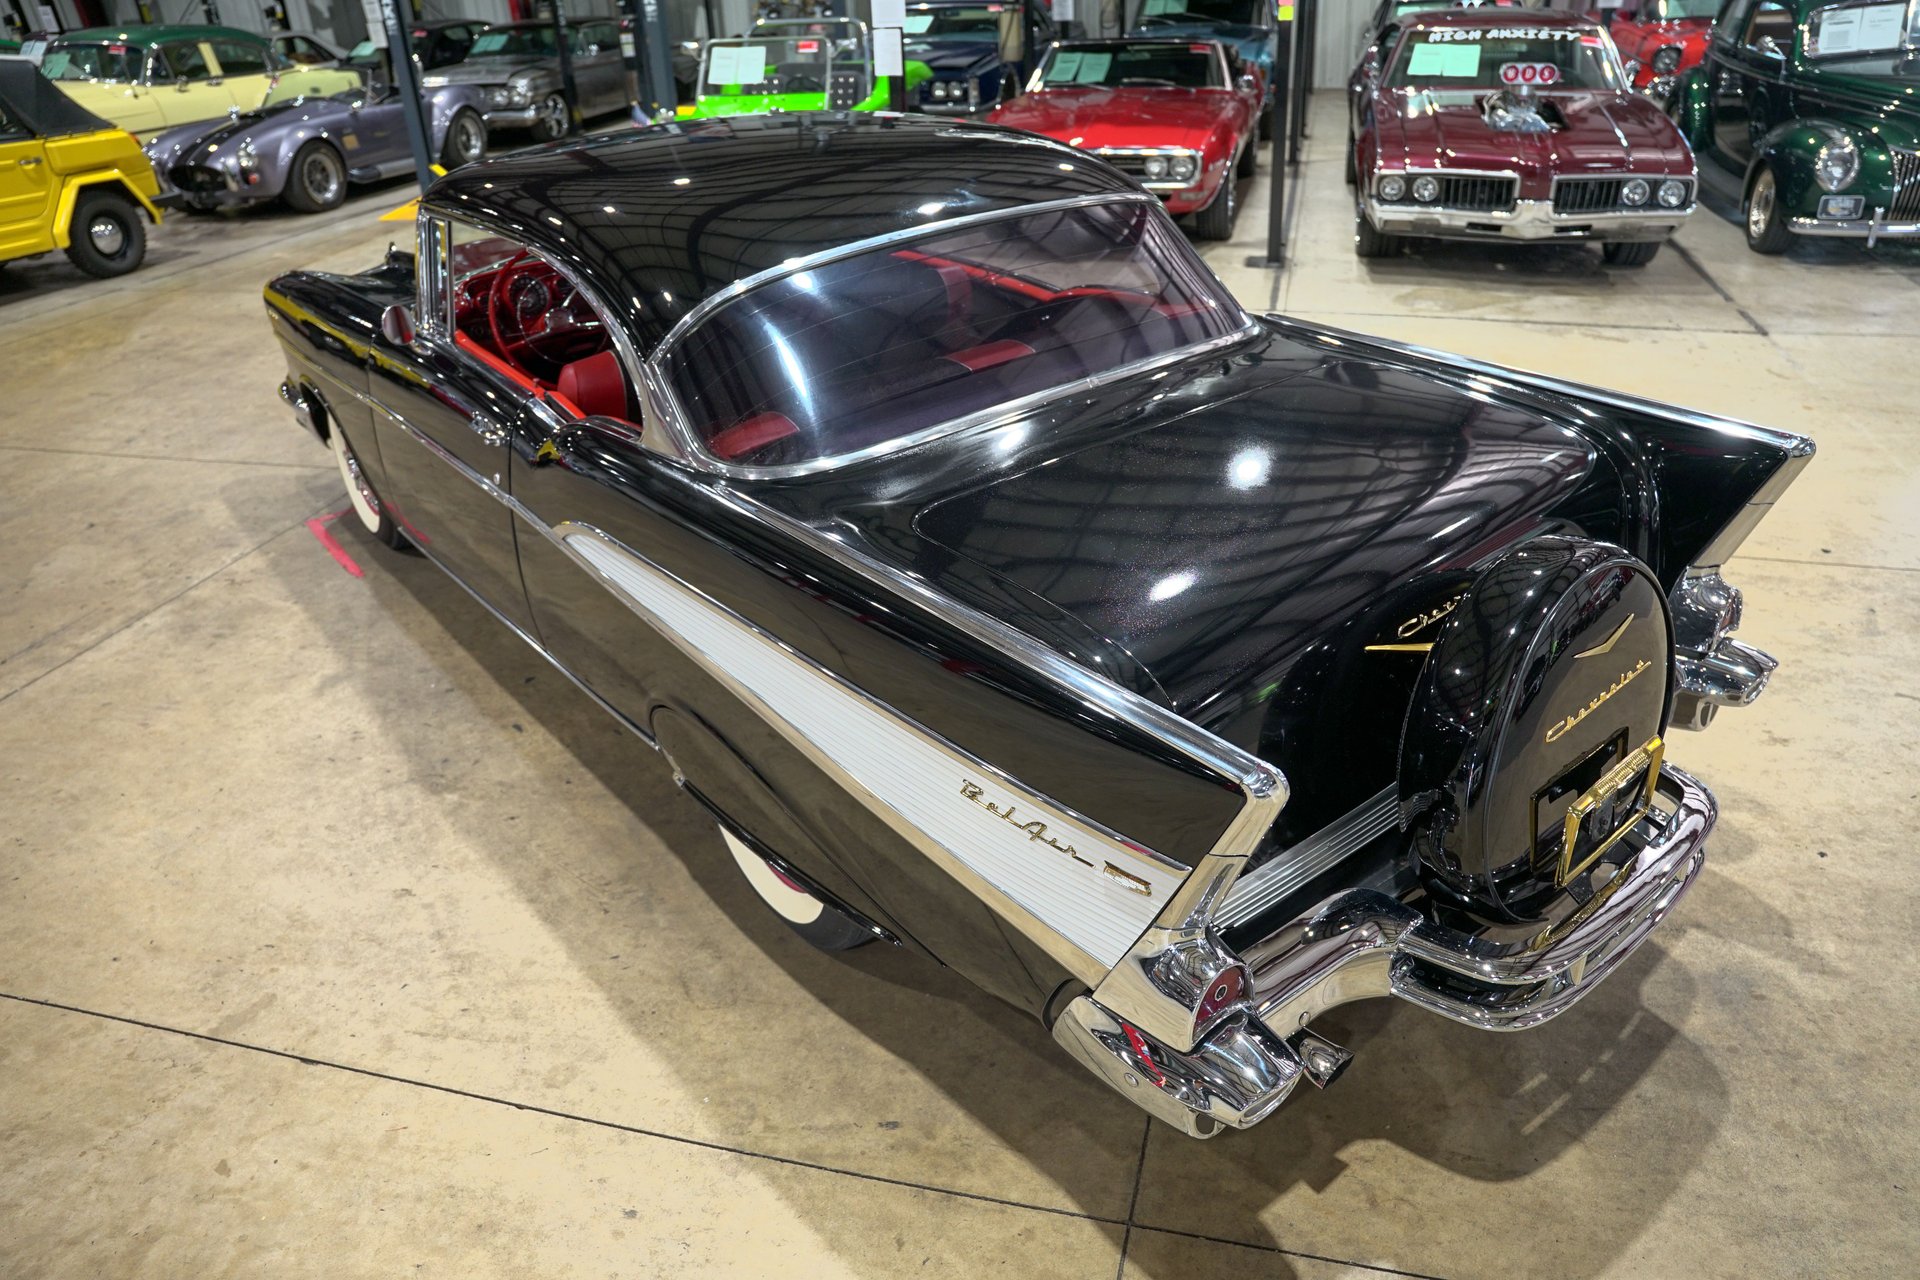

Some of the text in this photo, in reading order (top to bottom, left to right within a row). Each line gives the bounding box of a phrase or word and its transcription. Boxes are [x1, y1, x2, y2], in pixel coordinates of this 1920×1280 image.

[1428, 28, 1581, 43] HIGH ANXIETY
[1545, 659, 1652, 743] Chevrolet
